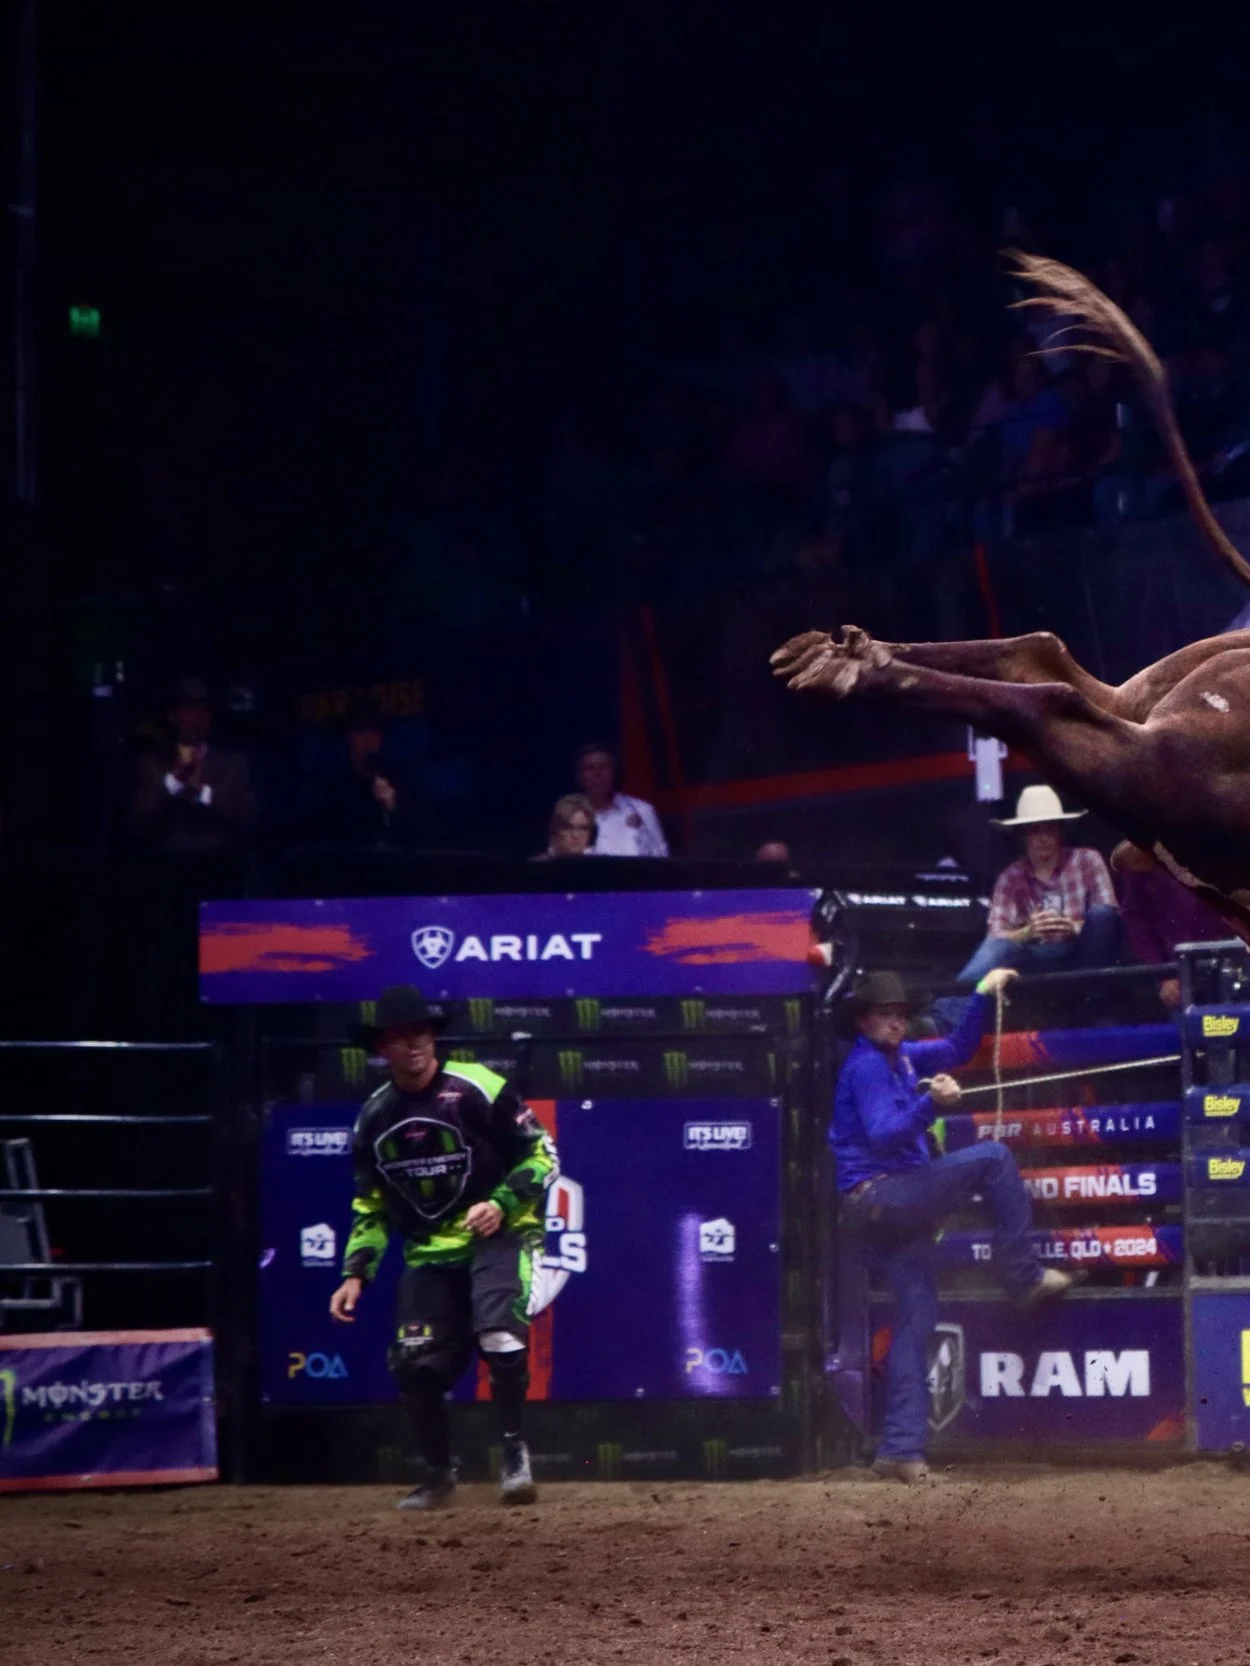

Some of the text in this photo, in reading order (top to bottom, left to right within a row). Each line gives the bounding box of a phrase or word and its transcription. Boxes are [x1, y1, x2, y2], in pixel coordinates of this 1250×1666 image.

[455, 934, 603, 962] ARIAT
[1204, 1095, 1240, 1114] Bisley
[1032, 1115, 1156, 1136] AUSTRALIA
[1208, 1158, 1245, 1177] Bisley
[1064, 1173, 1157, 1198] FINALS
[1114, 1238, 1157, 1257] 2024
[288, 1352, 348, 1378] POA
[685, 1347, 748, 1374] POA
[980, 1350, 1149, 1397] RAM
[22, 1379, 163, 1409] MONSTER
